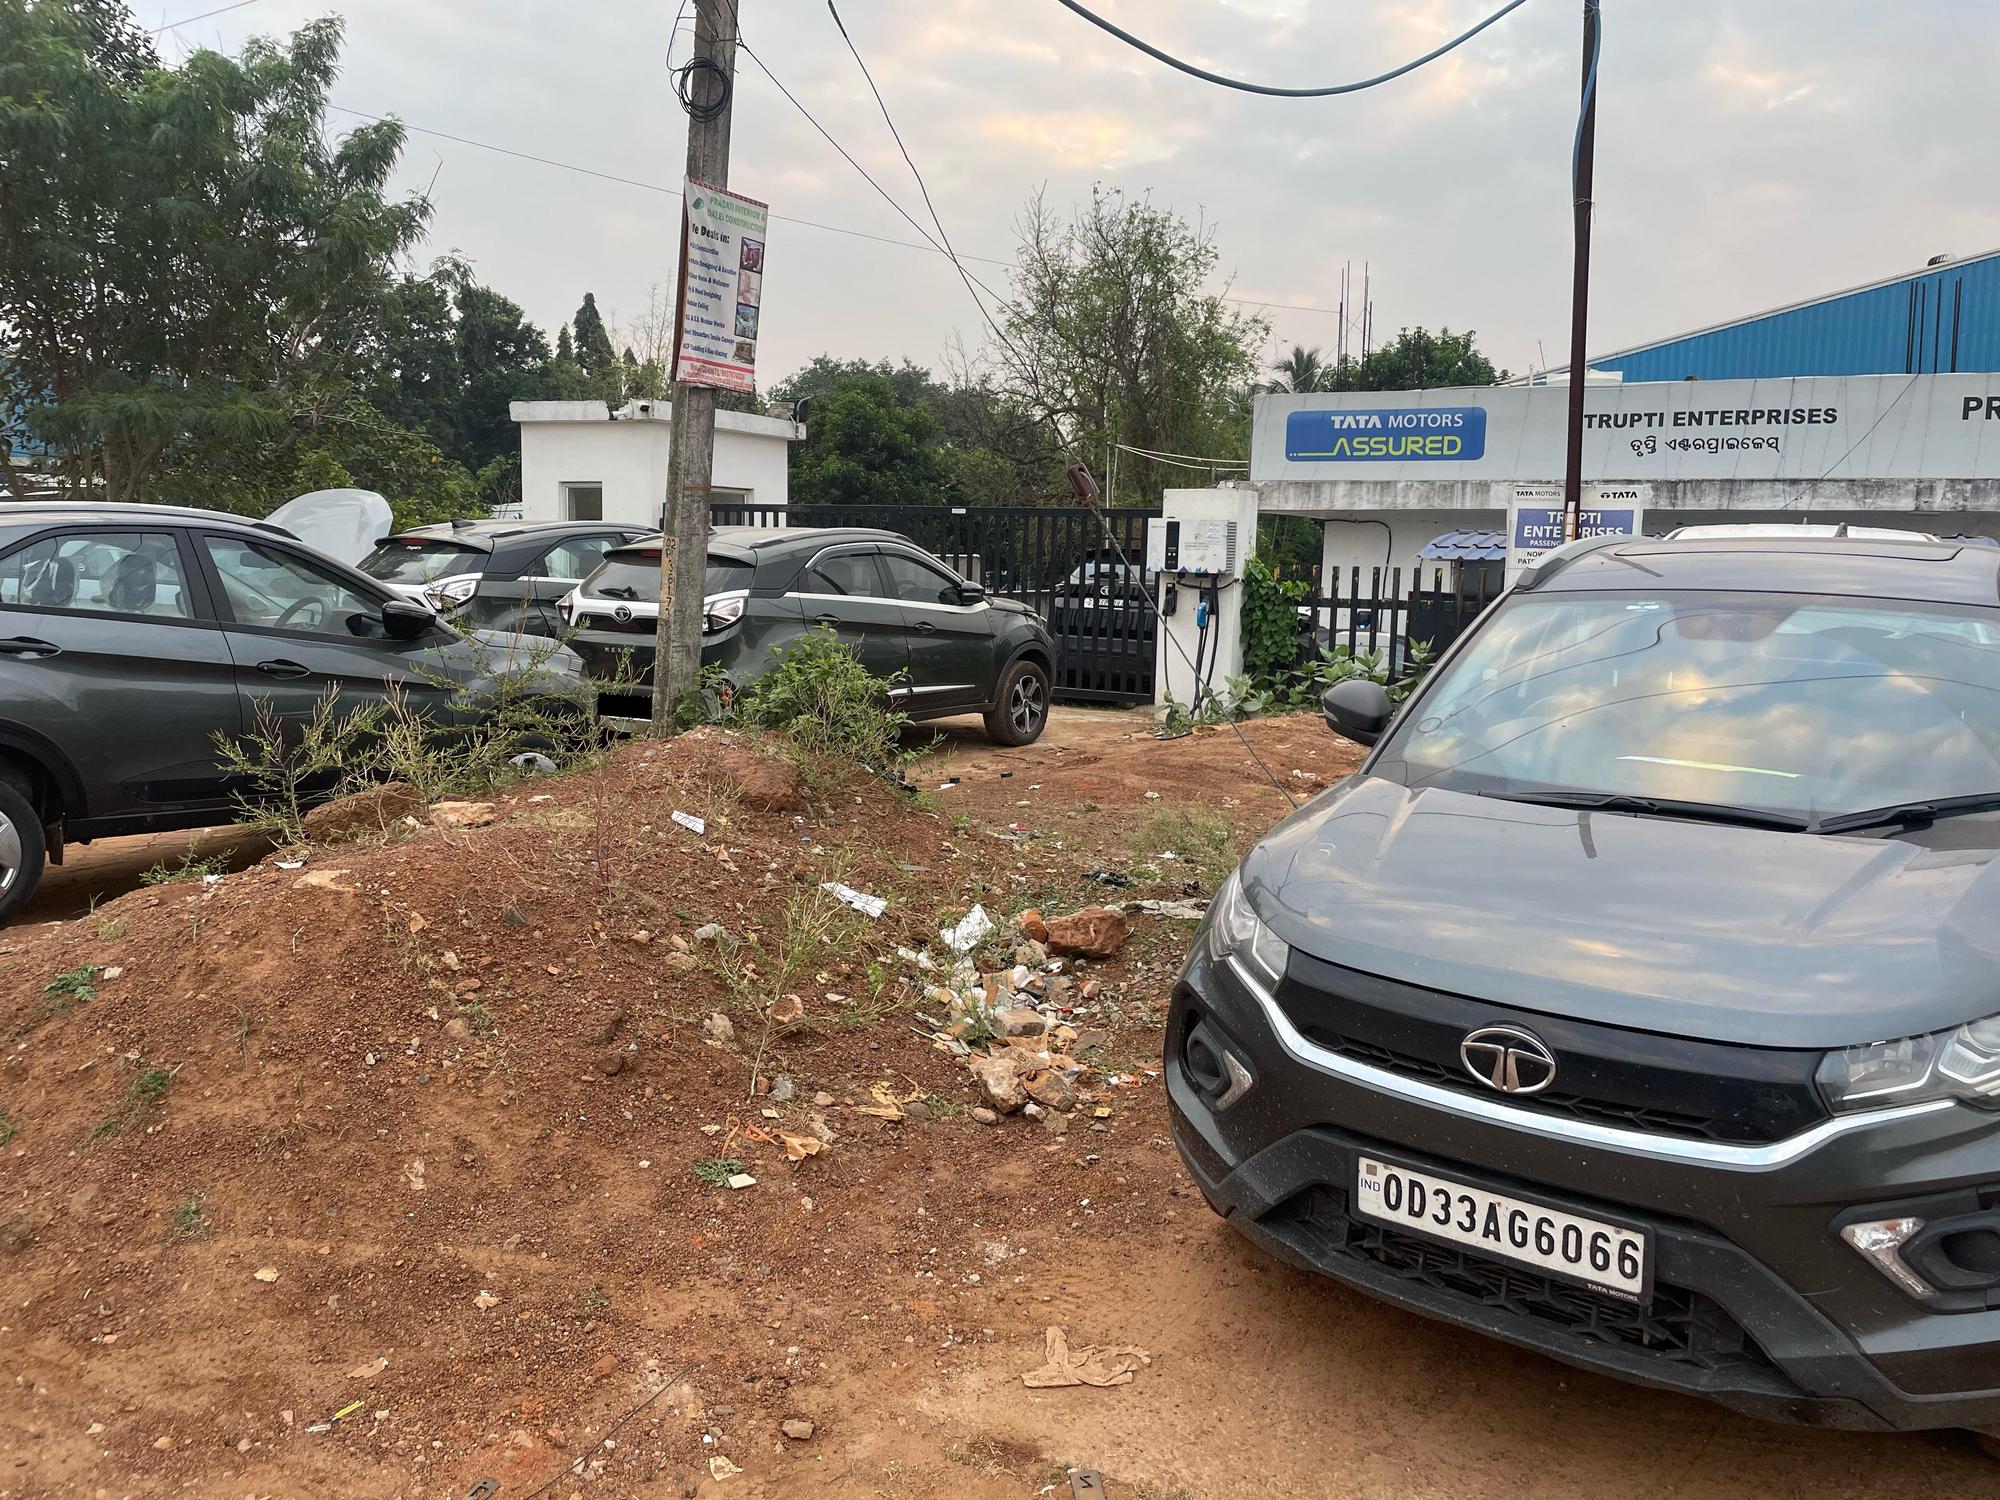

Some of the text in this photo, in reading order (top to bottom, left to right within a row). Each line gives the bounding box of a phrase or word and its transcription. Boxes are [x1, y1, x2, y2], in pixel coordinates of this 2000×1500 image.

[707, 208, 725, 222] DALEI
[734, 204, 760, 220] INTERIOR
[701, 225, 719, 240] Deals
[1961, 396, 2000, 420] PR
[1331, 413, 1463, 429] TATA MOTORS
[1583, 408, 1838, 429] TRUPTI ENTERPRISES
[1332, 435, 1462, 456] ASSURED
[1547, 511, 1601, 525] TRPTI
[1523, 526, 1624, 539] ENTERISES
[1529, 539, 1562, 547] PASSENG
[1360, 1177, 1381, 1192] IND
[1383, 1173, 1640, 1280] OD33AG6066
[1587, 1282, 1640, 1303] TATA MOTORS
